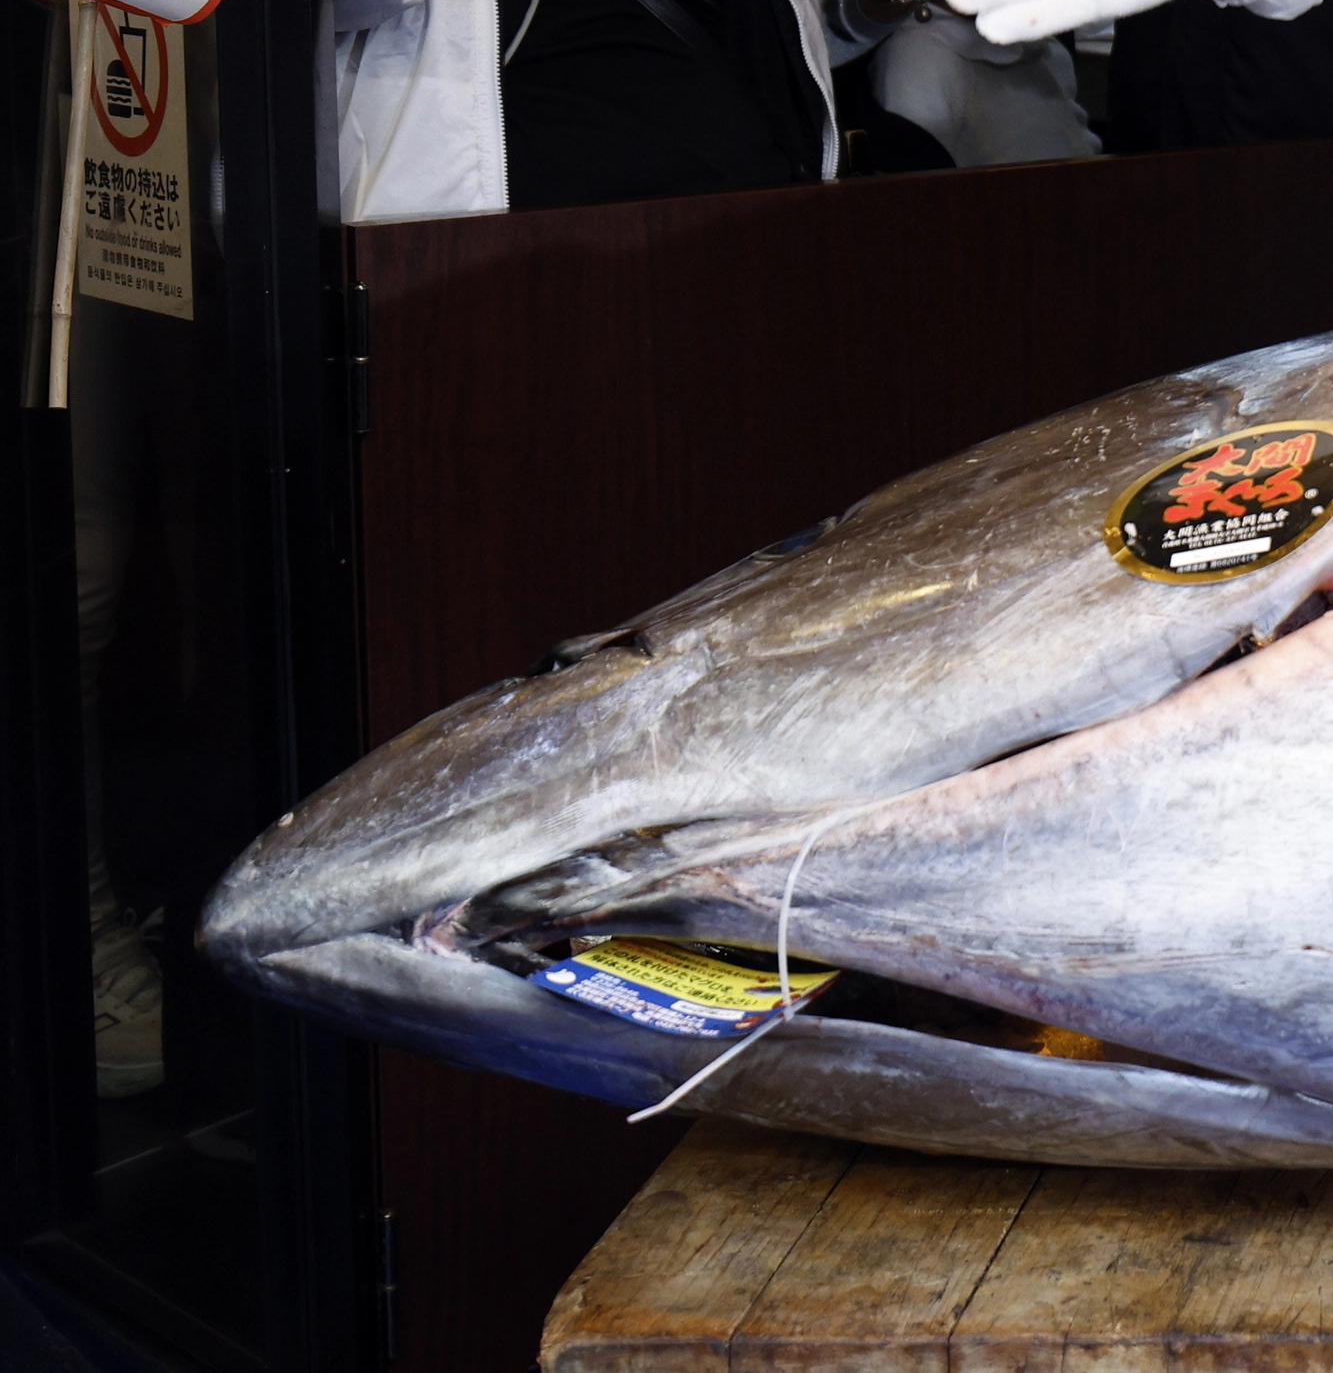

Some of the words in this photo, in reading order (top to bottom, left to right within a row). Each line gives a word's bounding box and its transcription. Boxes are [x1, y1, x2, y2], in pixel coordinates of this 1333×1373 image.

[84, 158, 180, 203] 飲食物の持込は
[139, 234, 158, 254] drinks
[159, 239, 182, 259] allowed
[157, 280, 183, 299] 주십시오
[1162, 468, 1307, 524] まぐろ
[1163, 508, 1290, 540] 大間漁業協同組合
